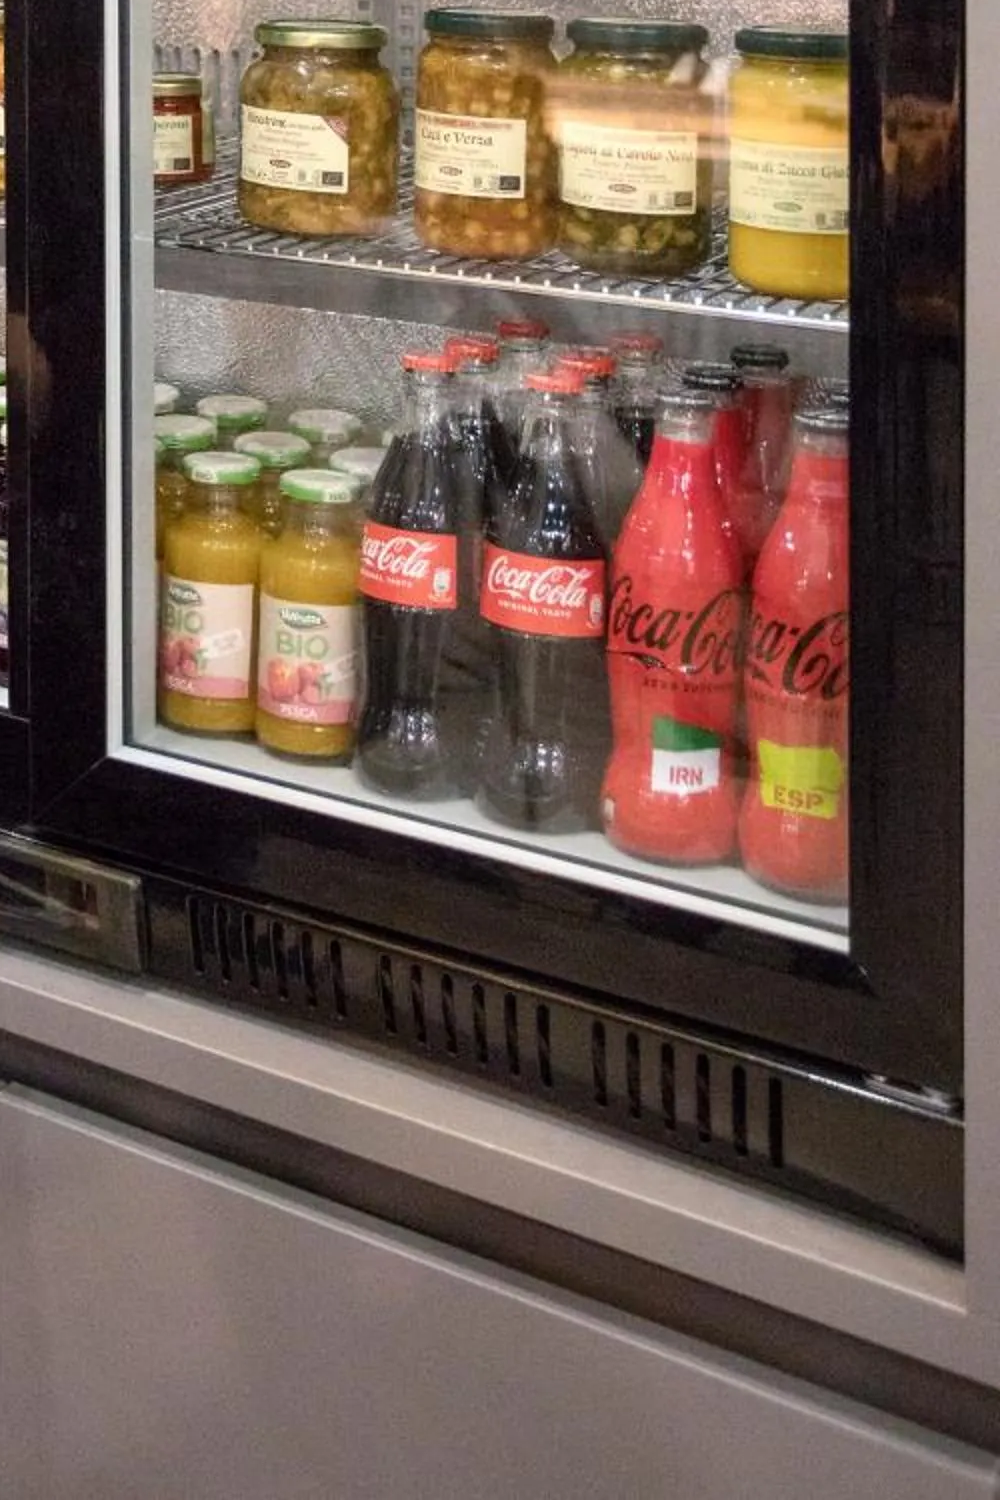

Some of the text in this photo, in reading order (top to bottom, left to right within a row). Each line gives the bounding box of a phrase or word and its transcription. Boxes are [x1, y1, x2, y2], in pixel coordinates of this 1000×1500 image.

[488, 555, 597, 608] Coca-Cola
[276, 630, 329, 660] BIO
[669, 765, 703, 785] IRN
[772, 787, 825, 809] ESP
